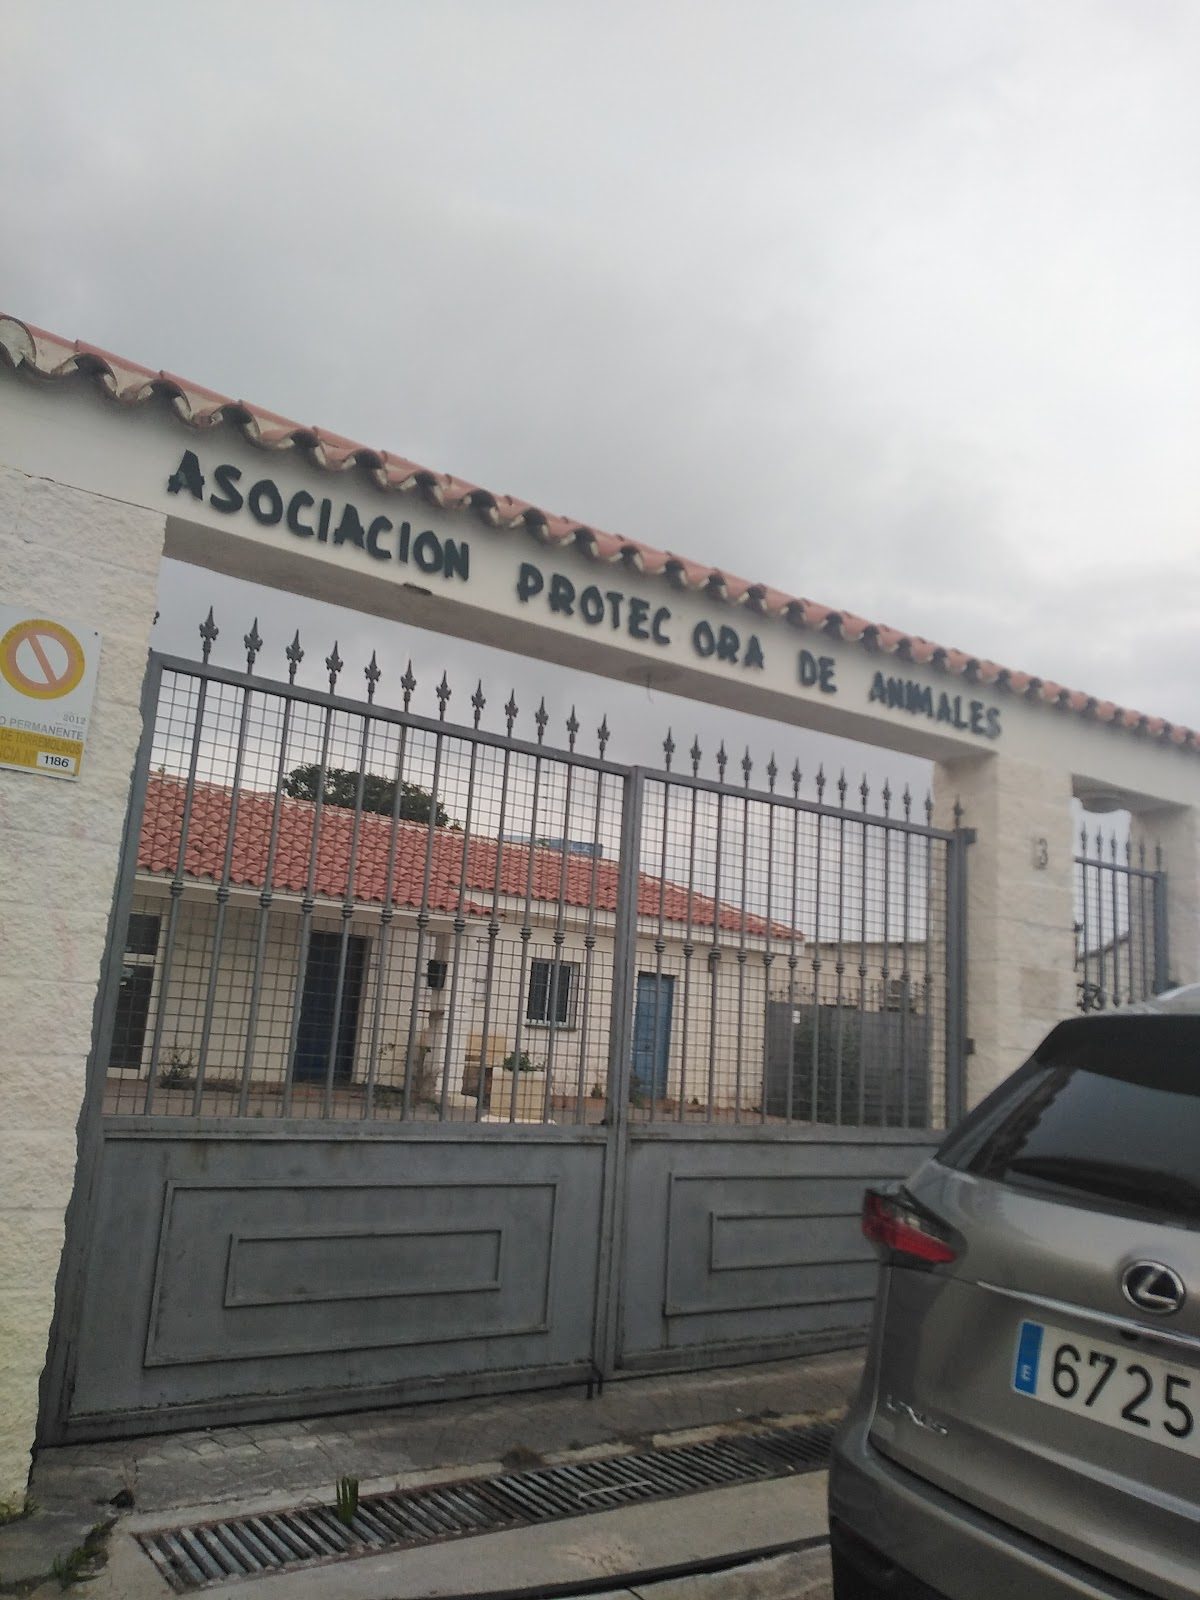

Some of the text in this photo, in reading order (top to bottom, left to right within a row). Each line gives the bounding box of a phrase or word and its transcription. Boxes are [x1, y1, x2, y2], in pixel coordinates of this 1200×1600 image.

[167, 449, 469, 582] ASOCIACION
[798, 649, 837, 694] DE
[868, 670, 1002, 739] ANIMALES
[9, 718, 83, 740] PERMANENTE
[63, 714, 86, 725] 2012
[45, 755, 70, 768] 1186
[1020, 1343, 1195, 1439] E 6725
